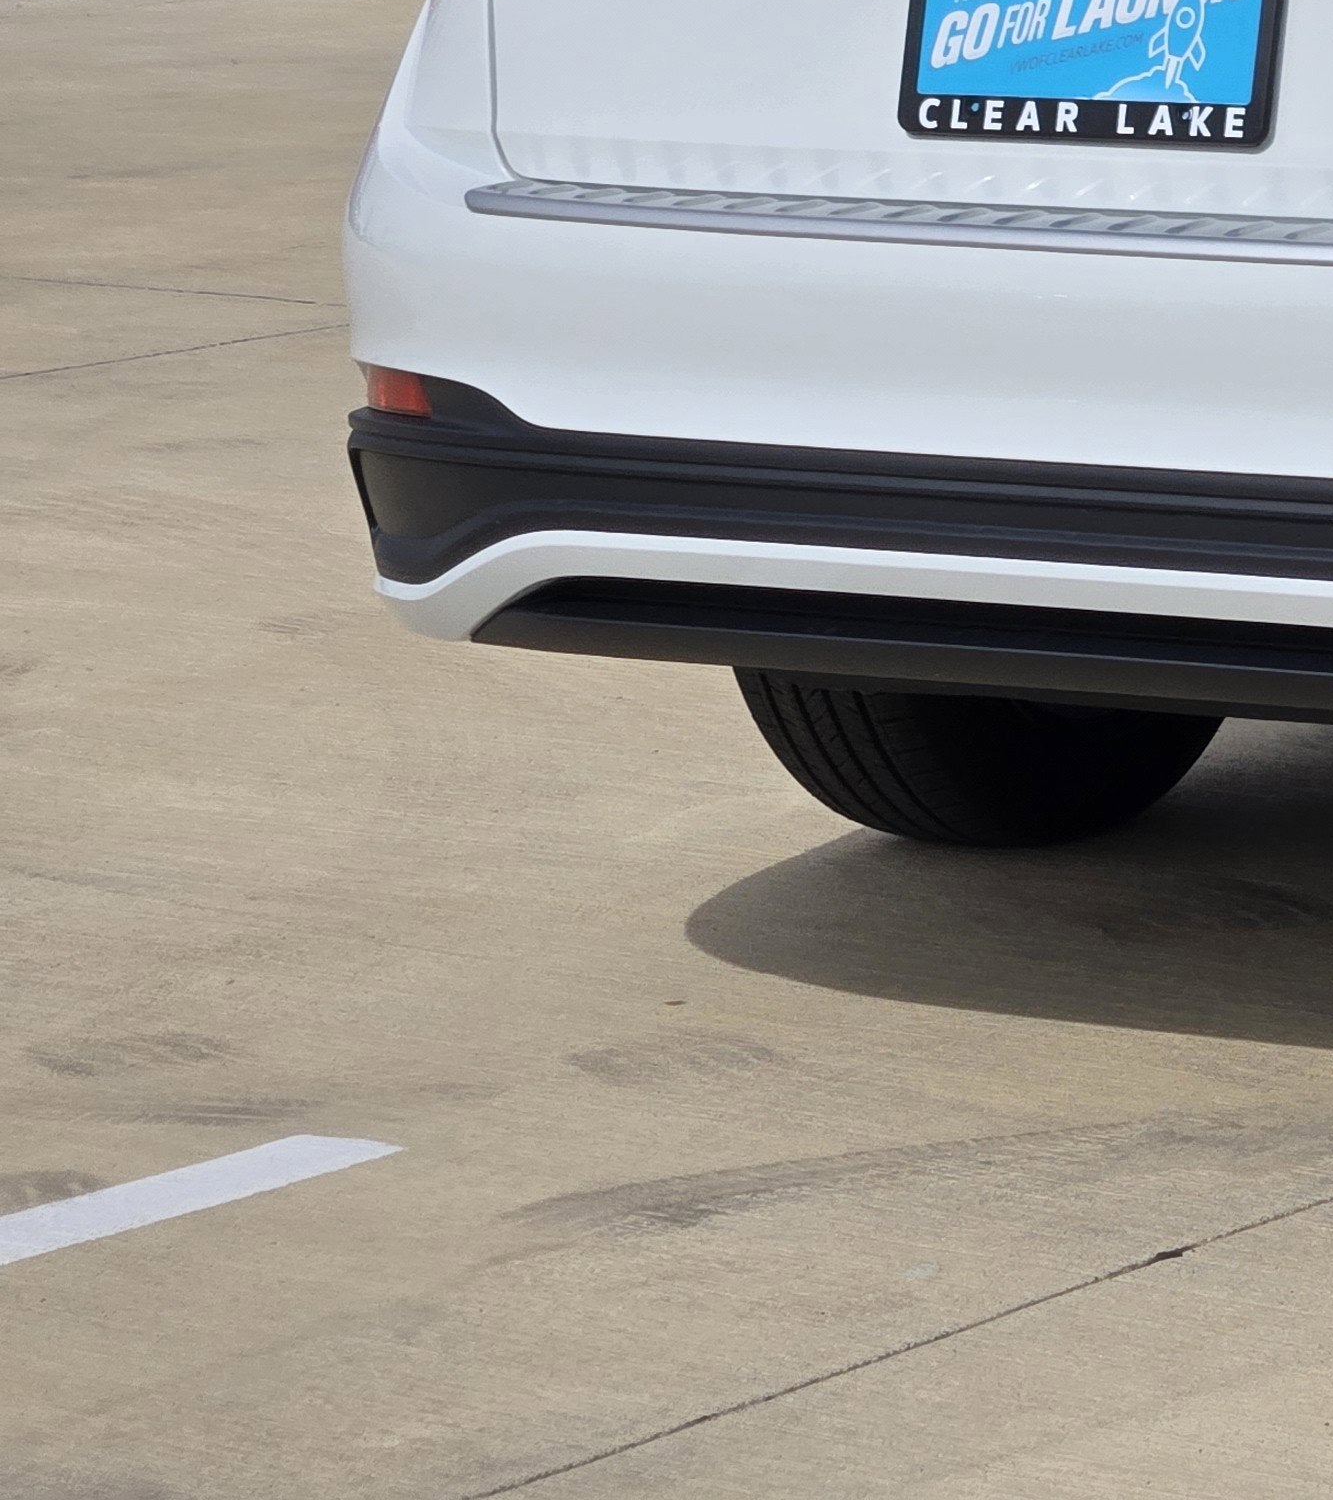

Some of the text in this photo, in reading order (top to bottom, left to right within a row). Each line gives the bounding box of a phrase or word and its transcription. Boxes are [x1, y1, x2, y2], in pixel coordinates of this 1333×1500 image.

[930, 2, 1001, 69] GO
[1009, 32, 1144, 75] VWOFCLEARLAKE.COM
[918, 99, 1247, 138] CLEAR LAKE
